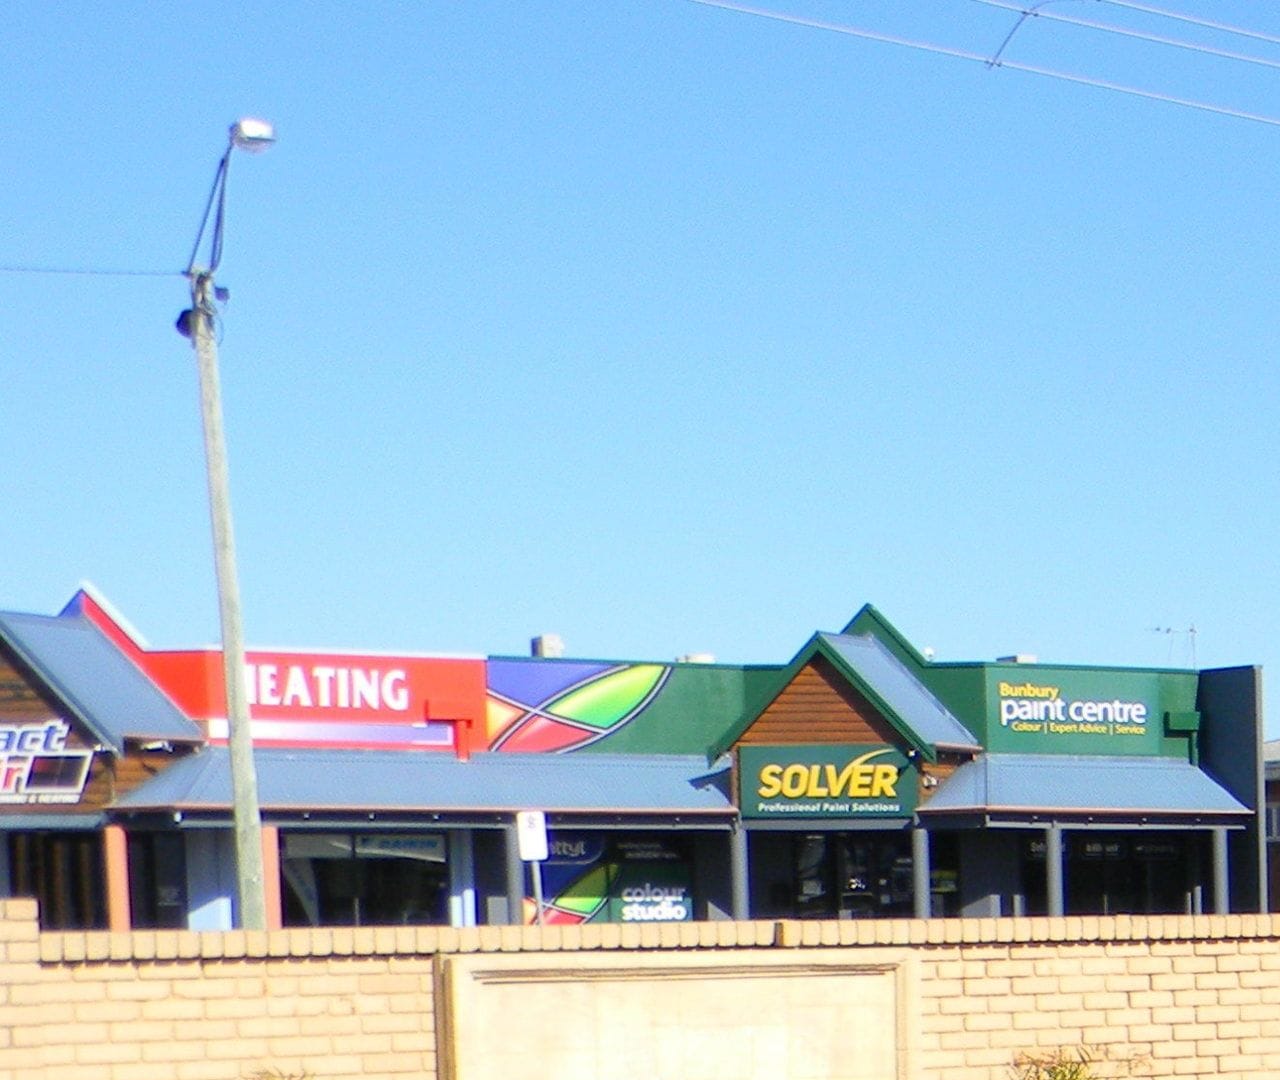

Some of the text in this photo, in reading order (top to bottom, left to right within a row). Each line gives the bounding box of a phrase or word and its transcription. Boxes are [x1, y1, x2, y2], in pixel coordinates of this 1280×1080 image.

[999, 682, 1059, 700] Bunbury
[1000, 697, 1147, 726] paint centre
[1011, 722, 1146, 734] Colour Expert Advice Service
[758, 749, 898, 798] SOLVER
[758, 802, 900, 812] Professional Paint Solutions
[621, 883, 686, 902] colour
[621, 901, 687, 922] studio
